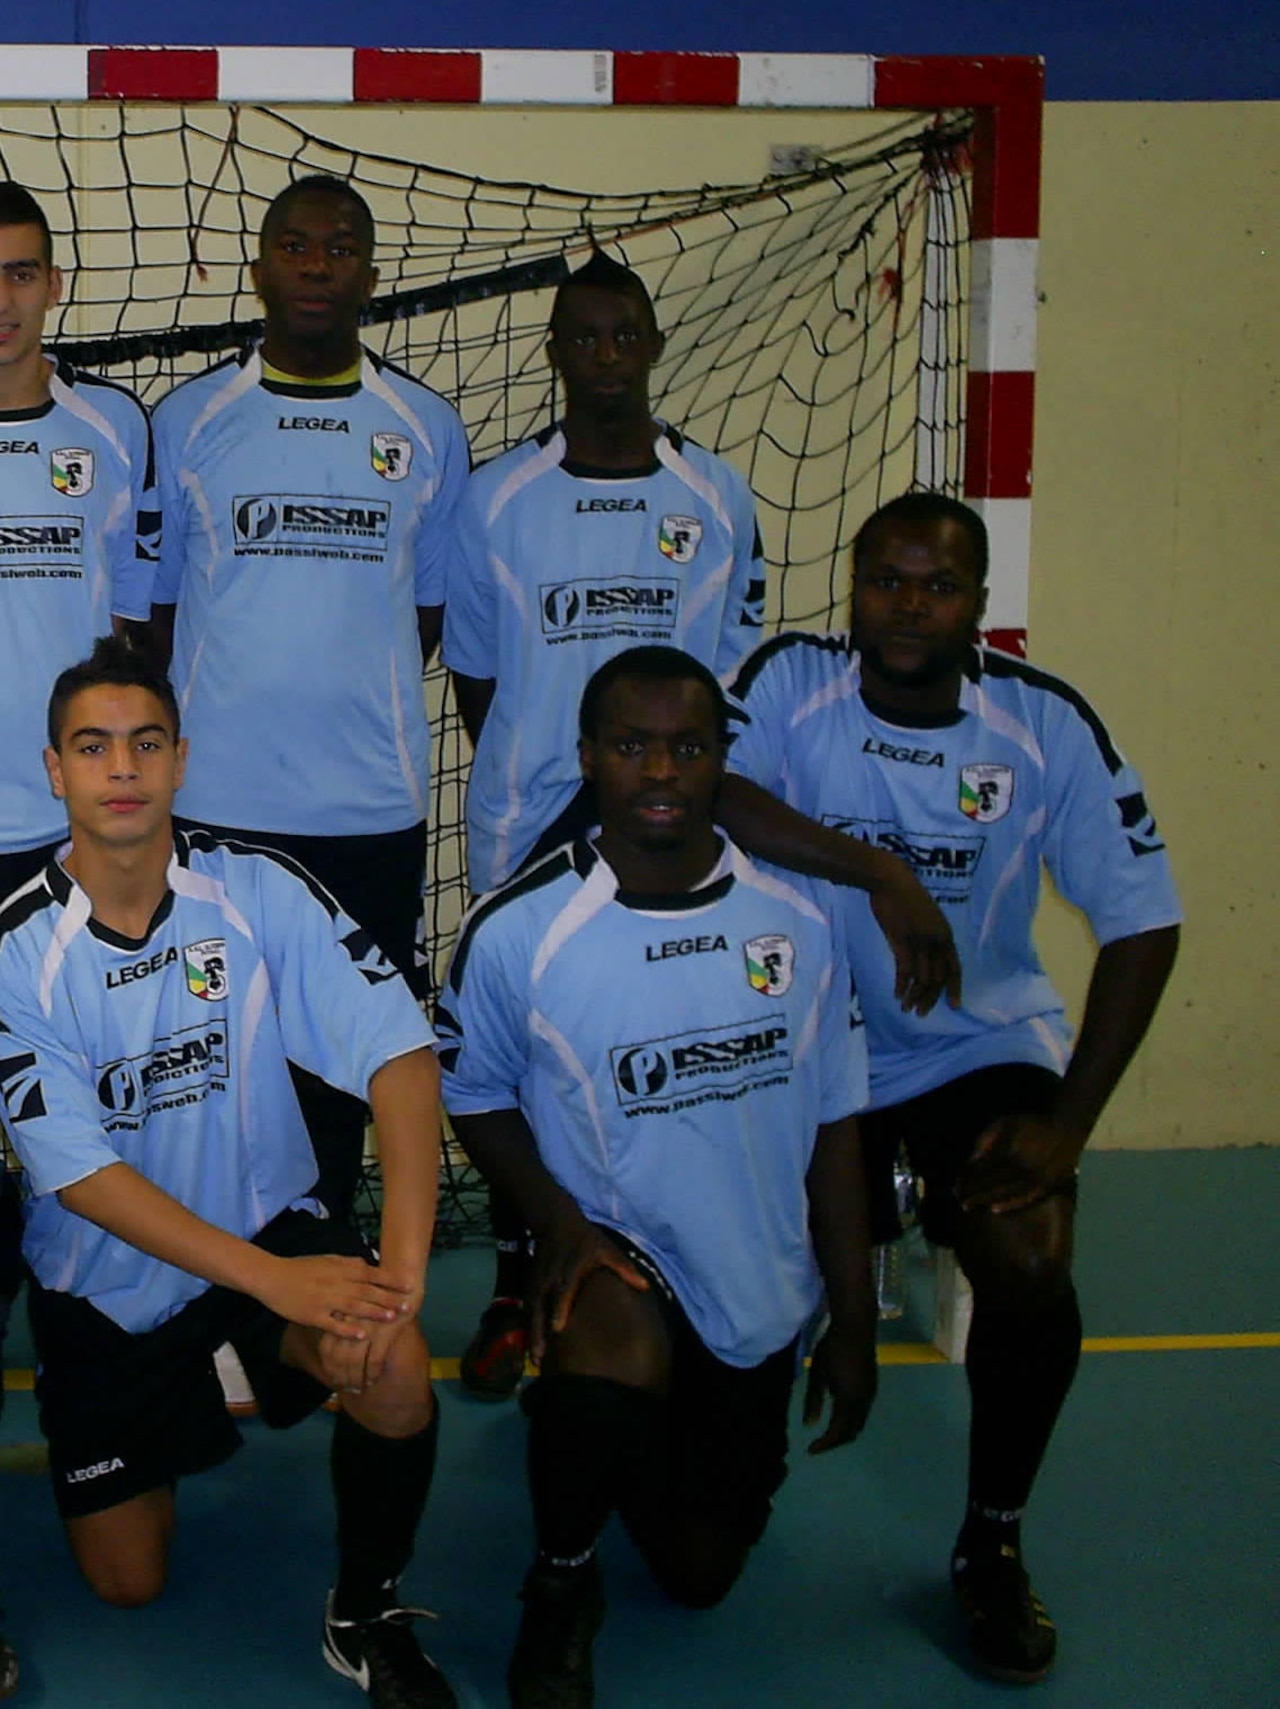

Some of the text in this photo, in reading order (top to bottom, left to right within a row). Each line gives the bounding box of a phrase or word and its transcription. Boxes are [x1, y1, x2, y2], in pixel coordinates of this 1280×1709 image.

[278, 416, 350, 433] LEGEA
[282, 504, 387, 529] ISSAP
[575, 498, 647, 513] LEGEA
[282, 524, 387, 539] PRODUCTIONS
[586, 587, 675, 607] ISSAP
[860, 738, 945, 767] LEGEA
[645, 935, 729, 962] LEGEA
[105, 947, 179, 990] LEGEA
[671, 1028, 788, 1071] ISSAP
[66, 1457, 125, 1484] LEGEA
